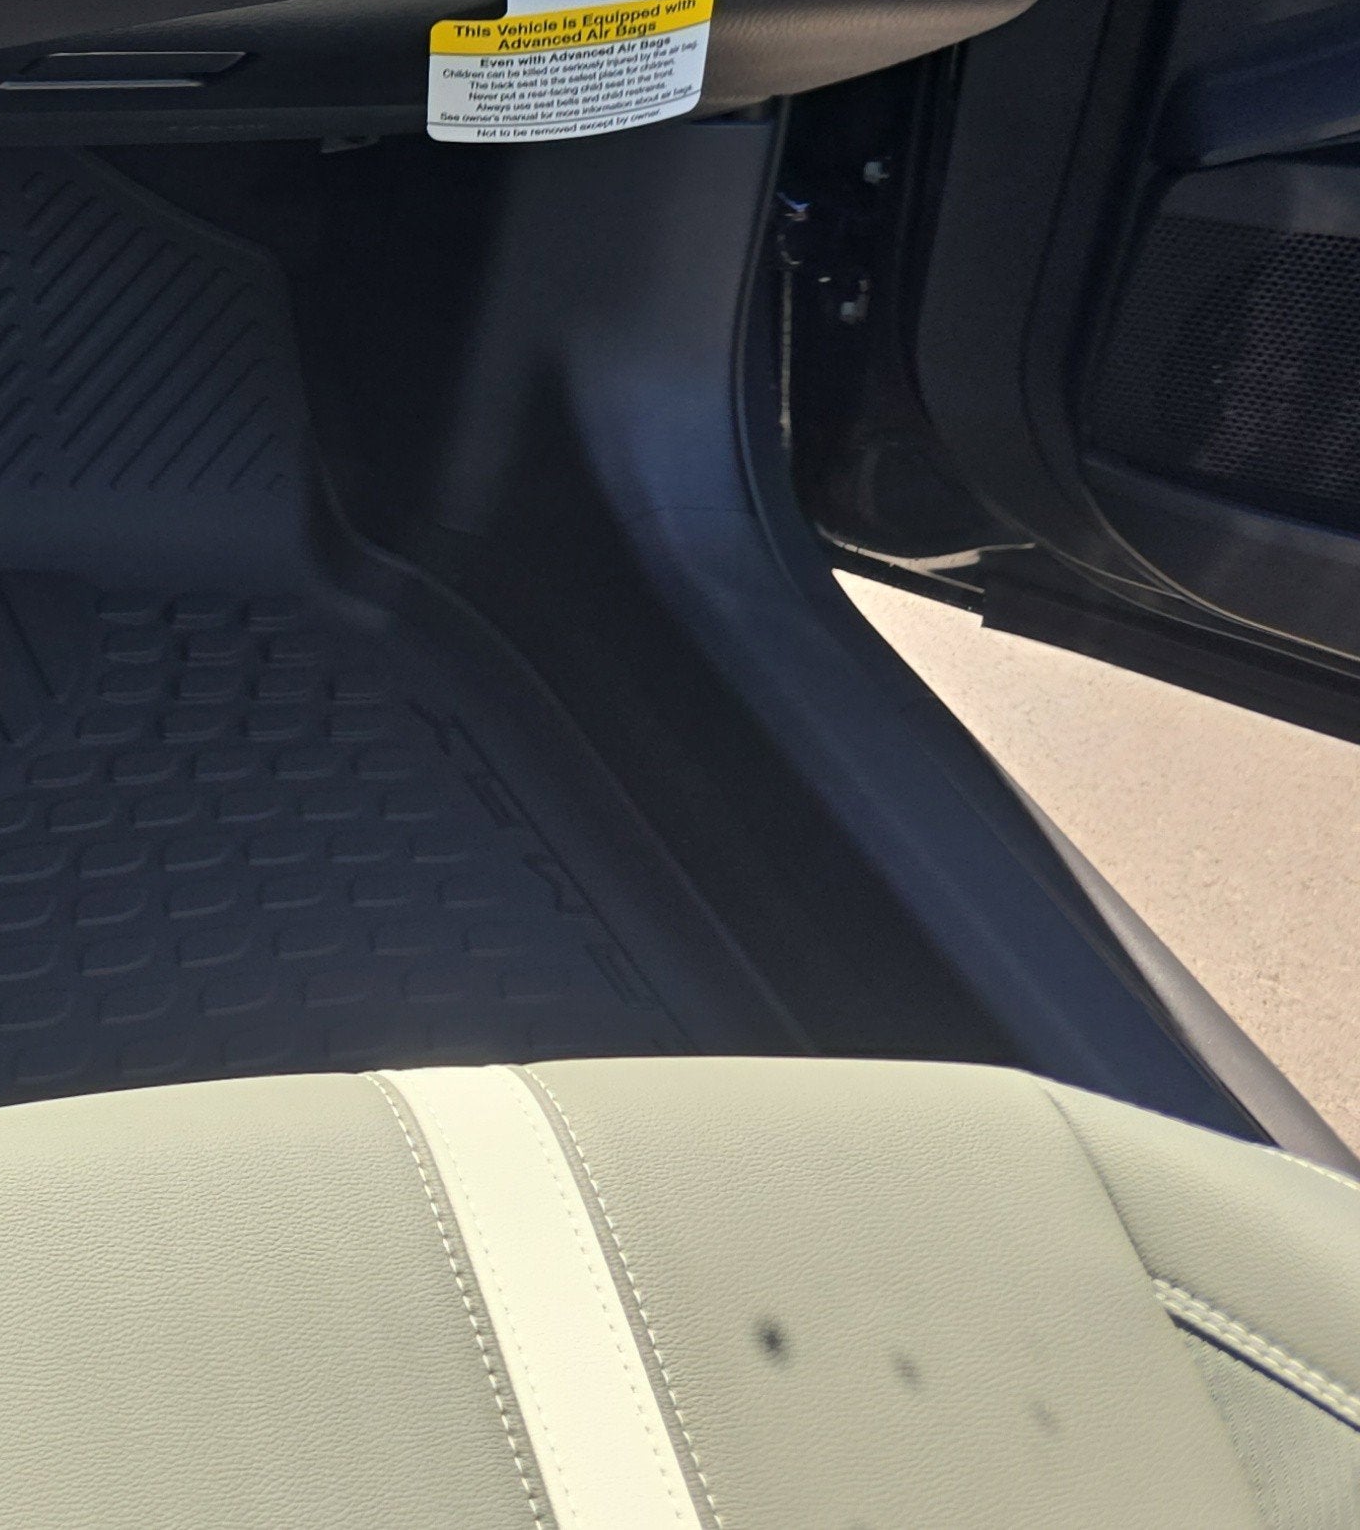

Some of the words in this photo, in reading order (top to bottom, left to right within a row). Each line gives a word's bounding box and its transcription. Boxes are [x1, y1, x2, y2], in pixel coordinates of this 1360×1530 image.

[453, 24, 491, 38] This
[496, 18, 558, 37] Vehicle
[562, 16, 577, 29] is
[582, 3, 661, 30] Equipped
[497, 29, 582, 51] Advanced
[586, 28, 612, 42] Air
[615, 22, 657, 37] Bags
[479, 57, 515, 69] Even
[518, 55, 547, 66] with
[549, 45, 615, 63] Advanced
[617, 41, 637, 54] Air
[640, 36, 672, 50] Bags
